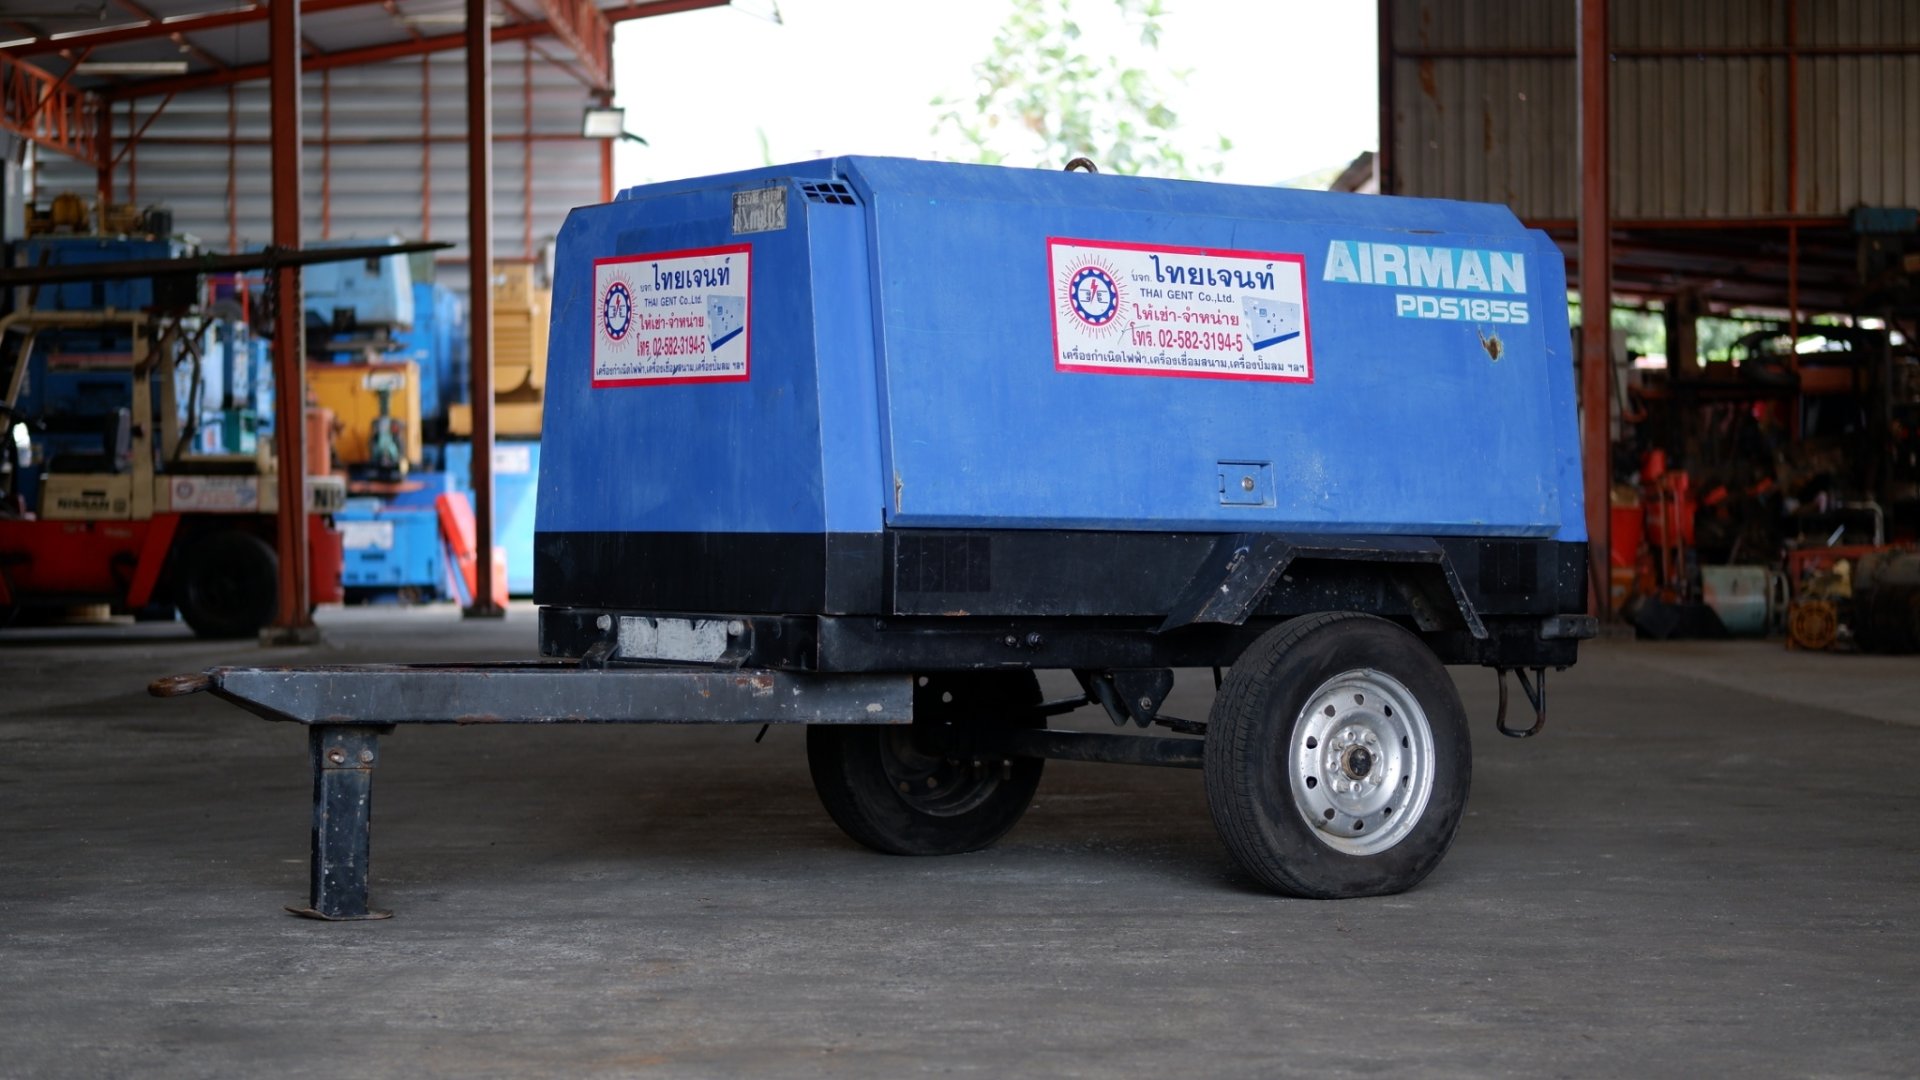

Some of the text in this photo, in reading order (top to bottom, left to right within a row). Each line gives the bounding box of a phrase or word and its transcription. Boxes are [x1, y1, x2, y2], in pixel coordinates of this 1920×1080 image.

[652, 257, 730, 292] ไทยเจนท์
[1150, 255, 1274, 290] ไทยเจนท์
[1322, 240, 1527, 294] AIRMAN
[644, 297, 658, 308] THAI
[661, 296, 677, 306] GENT
[1140, 287, 1235, 304] THAI GENT Co.,Ltd.
[638, 311, 704, 329] ให้เช่า-จำหน่าย
[1133, 303, 1239, 326] ให้เช่า-จำหน่าย
[1395, 293, 1530, 325] PDS185S
[653, 334, 705, 357] 02-582-3194-5
[1130, 322, 1243, 352] โทร. 02-582-3194-5
